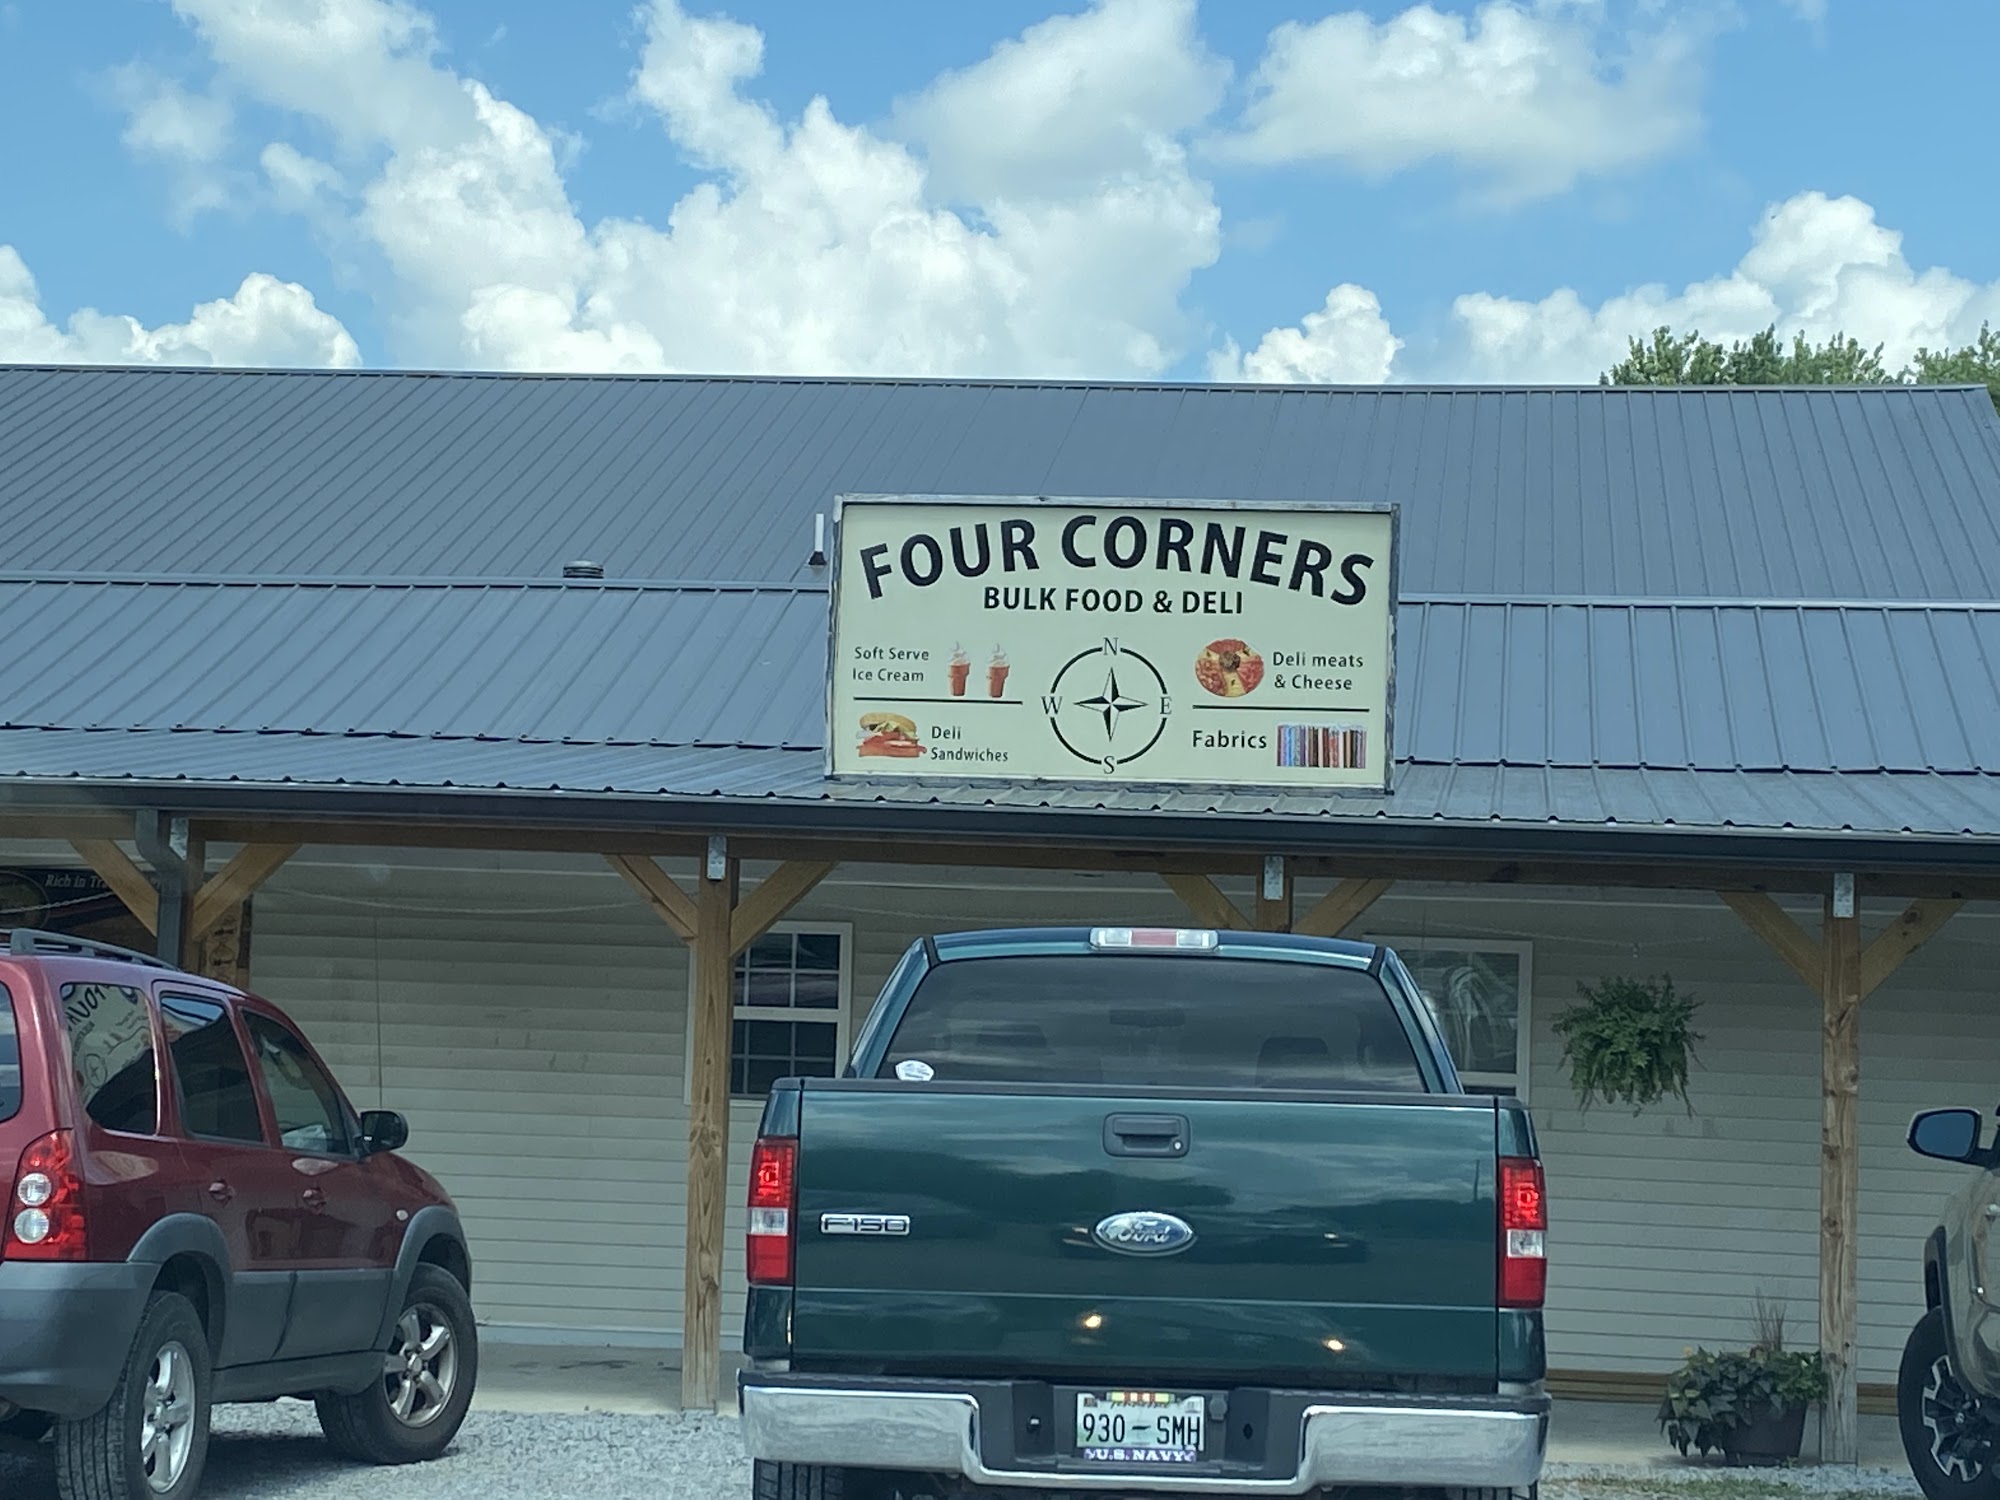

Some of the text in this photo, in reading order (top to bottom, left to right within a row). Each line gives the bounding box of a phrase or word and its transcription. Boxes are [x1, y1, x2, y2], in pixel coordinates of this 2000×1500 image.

[859, 514, 1375, 607] FOUR CORNERS
[983, 586, 1244, 615] BULK FOOD & DELI
[854, 646, 930, 661] Soft Serve
[1101, 637, 1119, 656] N
[1272, 651, 1364, 668] Deli meats
[852, 667, 924, 682] Ice Cream
[1274, 674, 1353, 690] & Cheese
[1041, 696, 1063, 716] W
[1159, 697, 1172, 715] E
[931, 726, 961, 740] Deli
[1192, 730, 1267, 749] Fabrics
[930, 746, 1009, 762] Sandwiches
[1103, 755, 1116, 775] S
[1083, 1413, 1200, 1448] 930 SMH
[1132, 1450, 1185, 1462] NAVY
